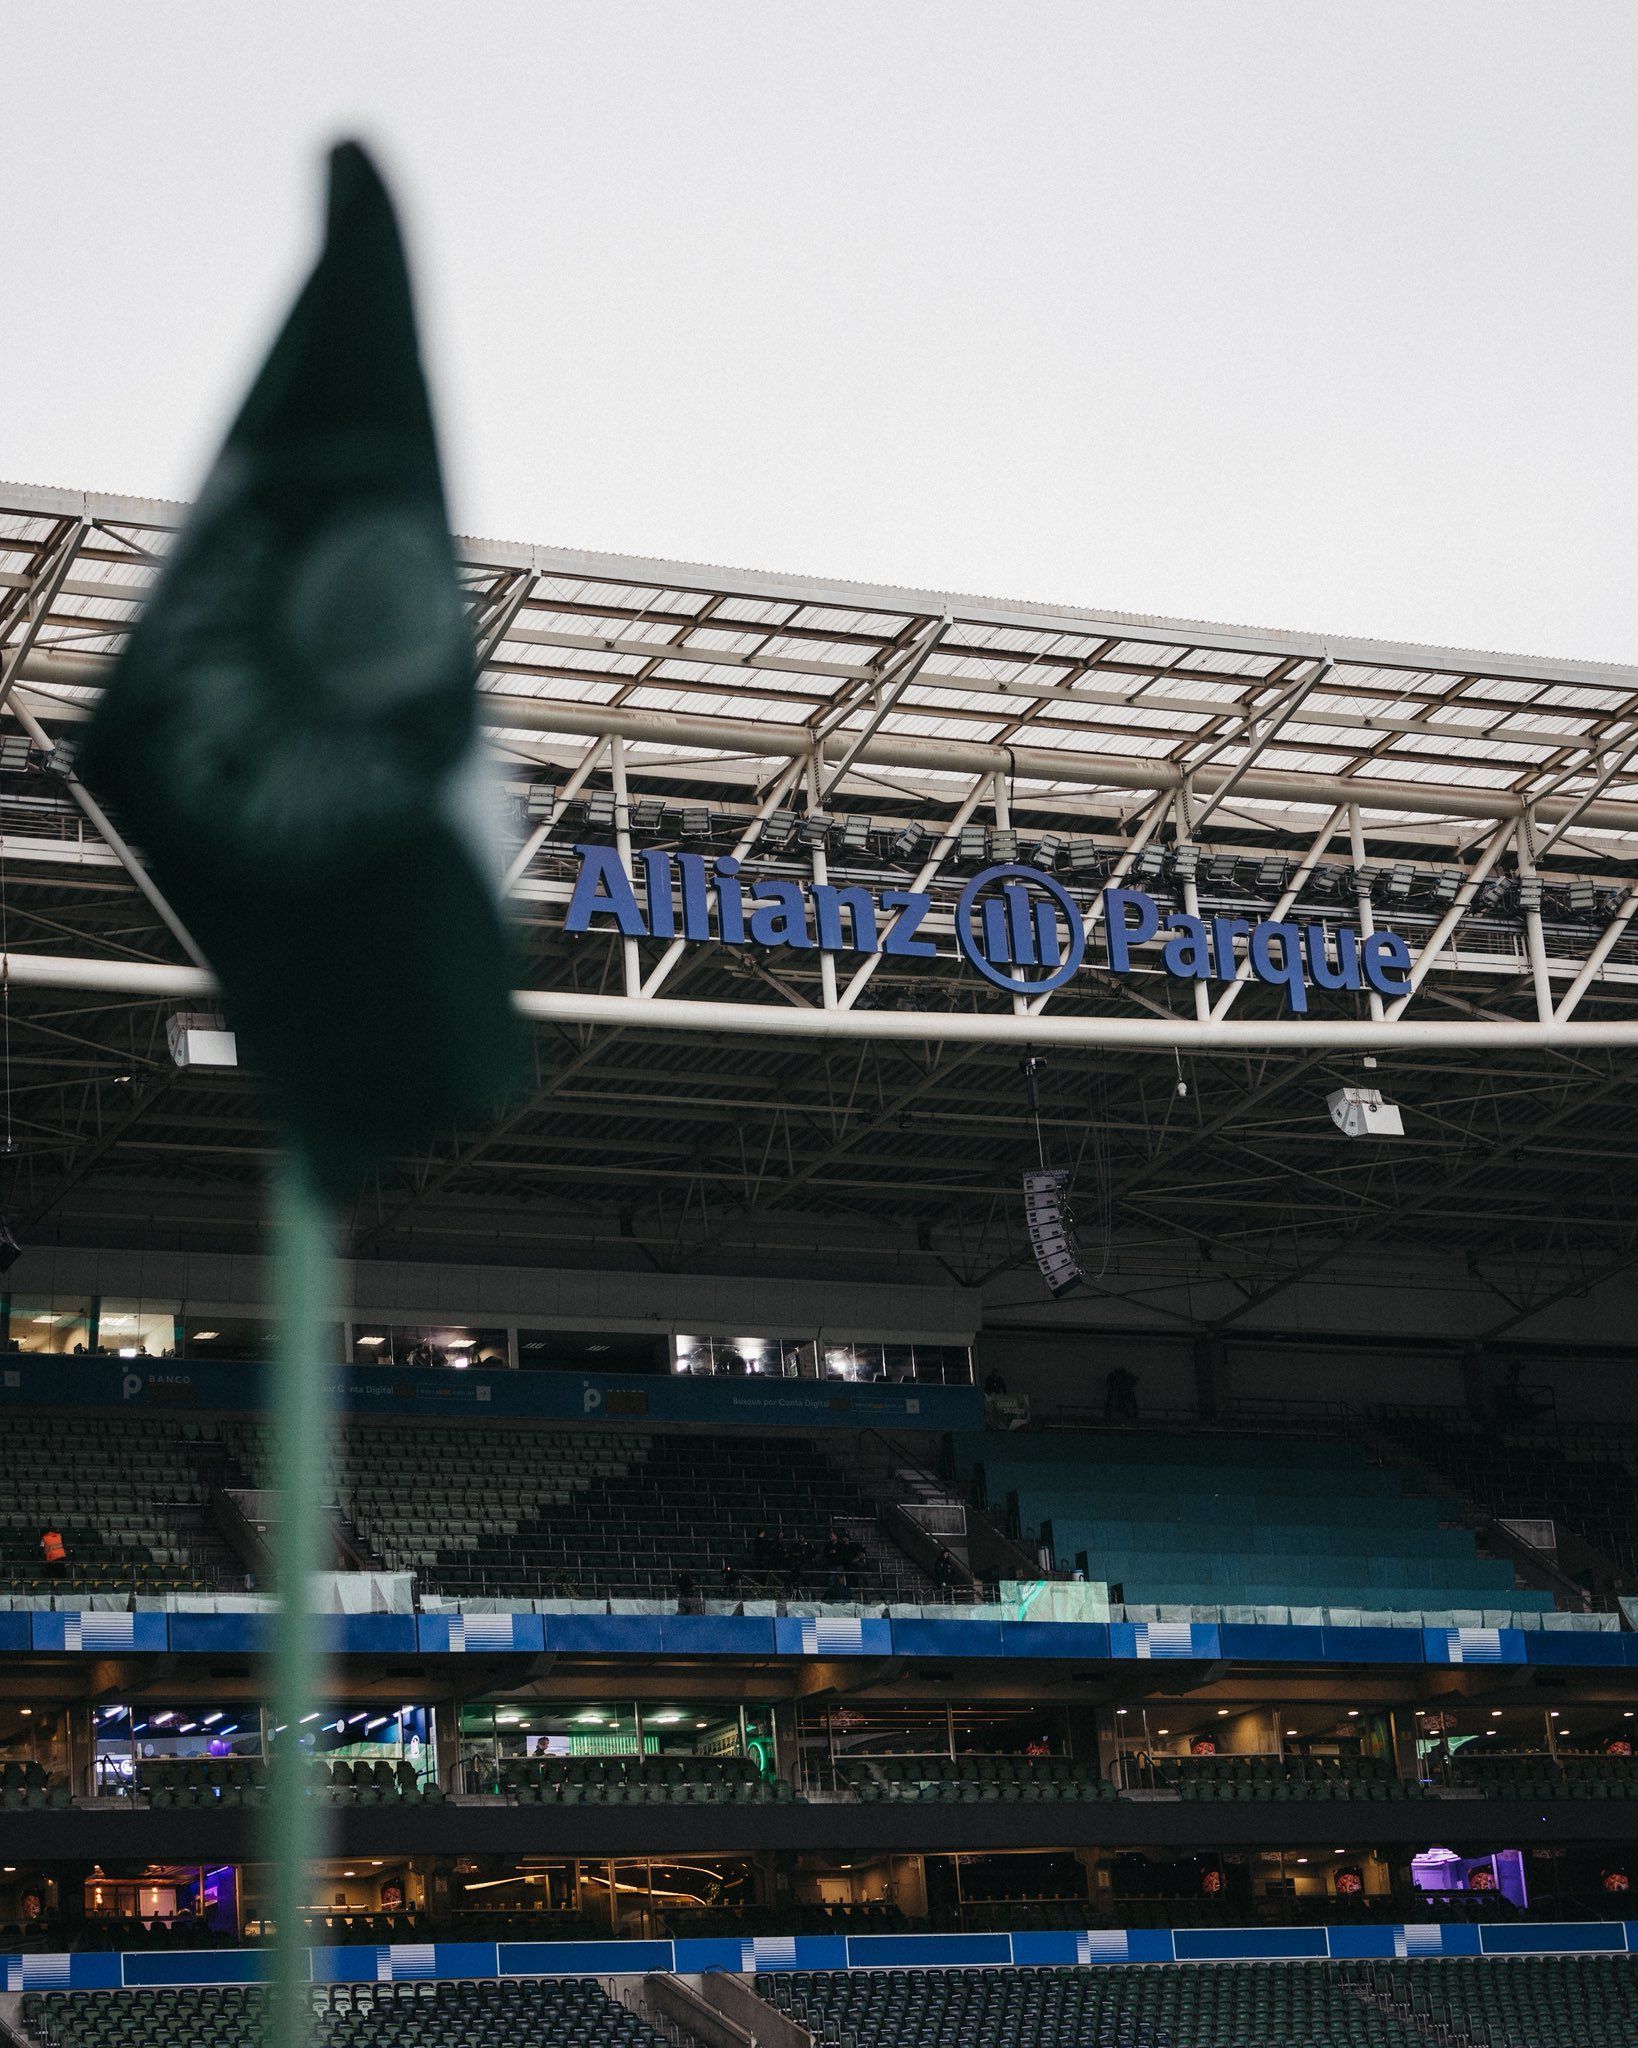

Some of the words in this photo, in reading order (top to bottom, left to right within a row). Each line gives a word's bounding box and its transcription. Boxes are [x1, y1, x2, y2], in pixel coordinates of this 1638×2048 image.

[563, 844, 936, 958] Allianz
[1103, 888, 1411, 1012] Parque
[148, 1376, 192, 1384] BANCO
[338, 1384, 364, 1394] Cnta
[365, 1385, 393, 1396] Digital
[779, 1398, 803, 1407] Conta
[805, 1399, 830, 1410] Digital
